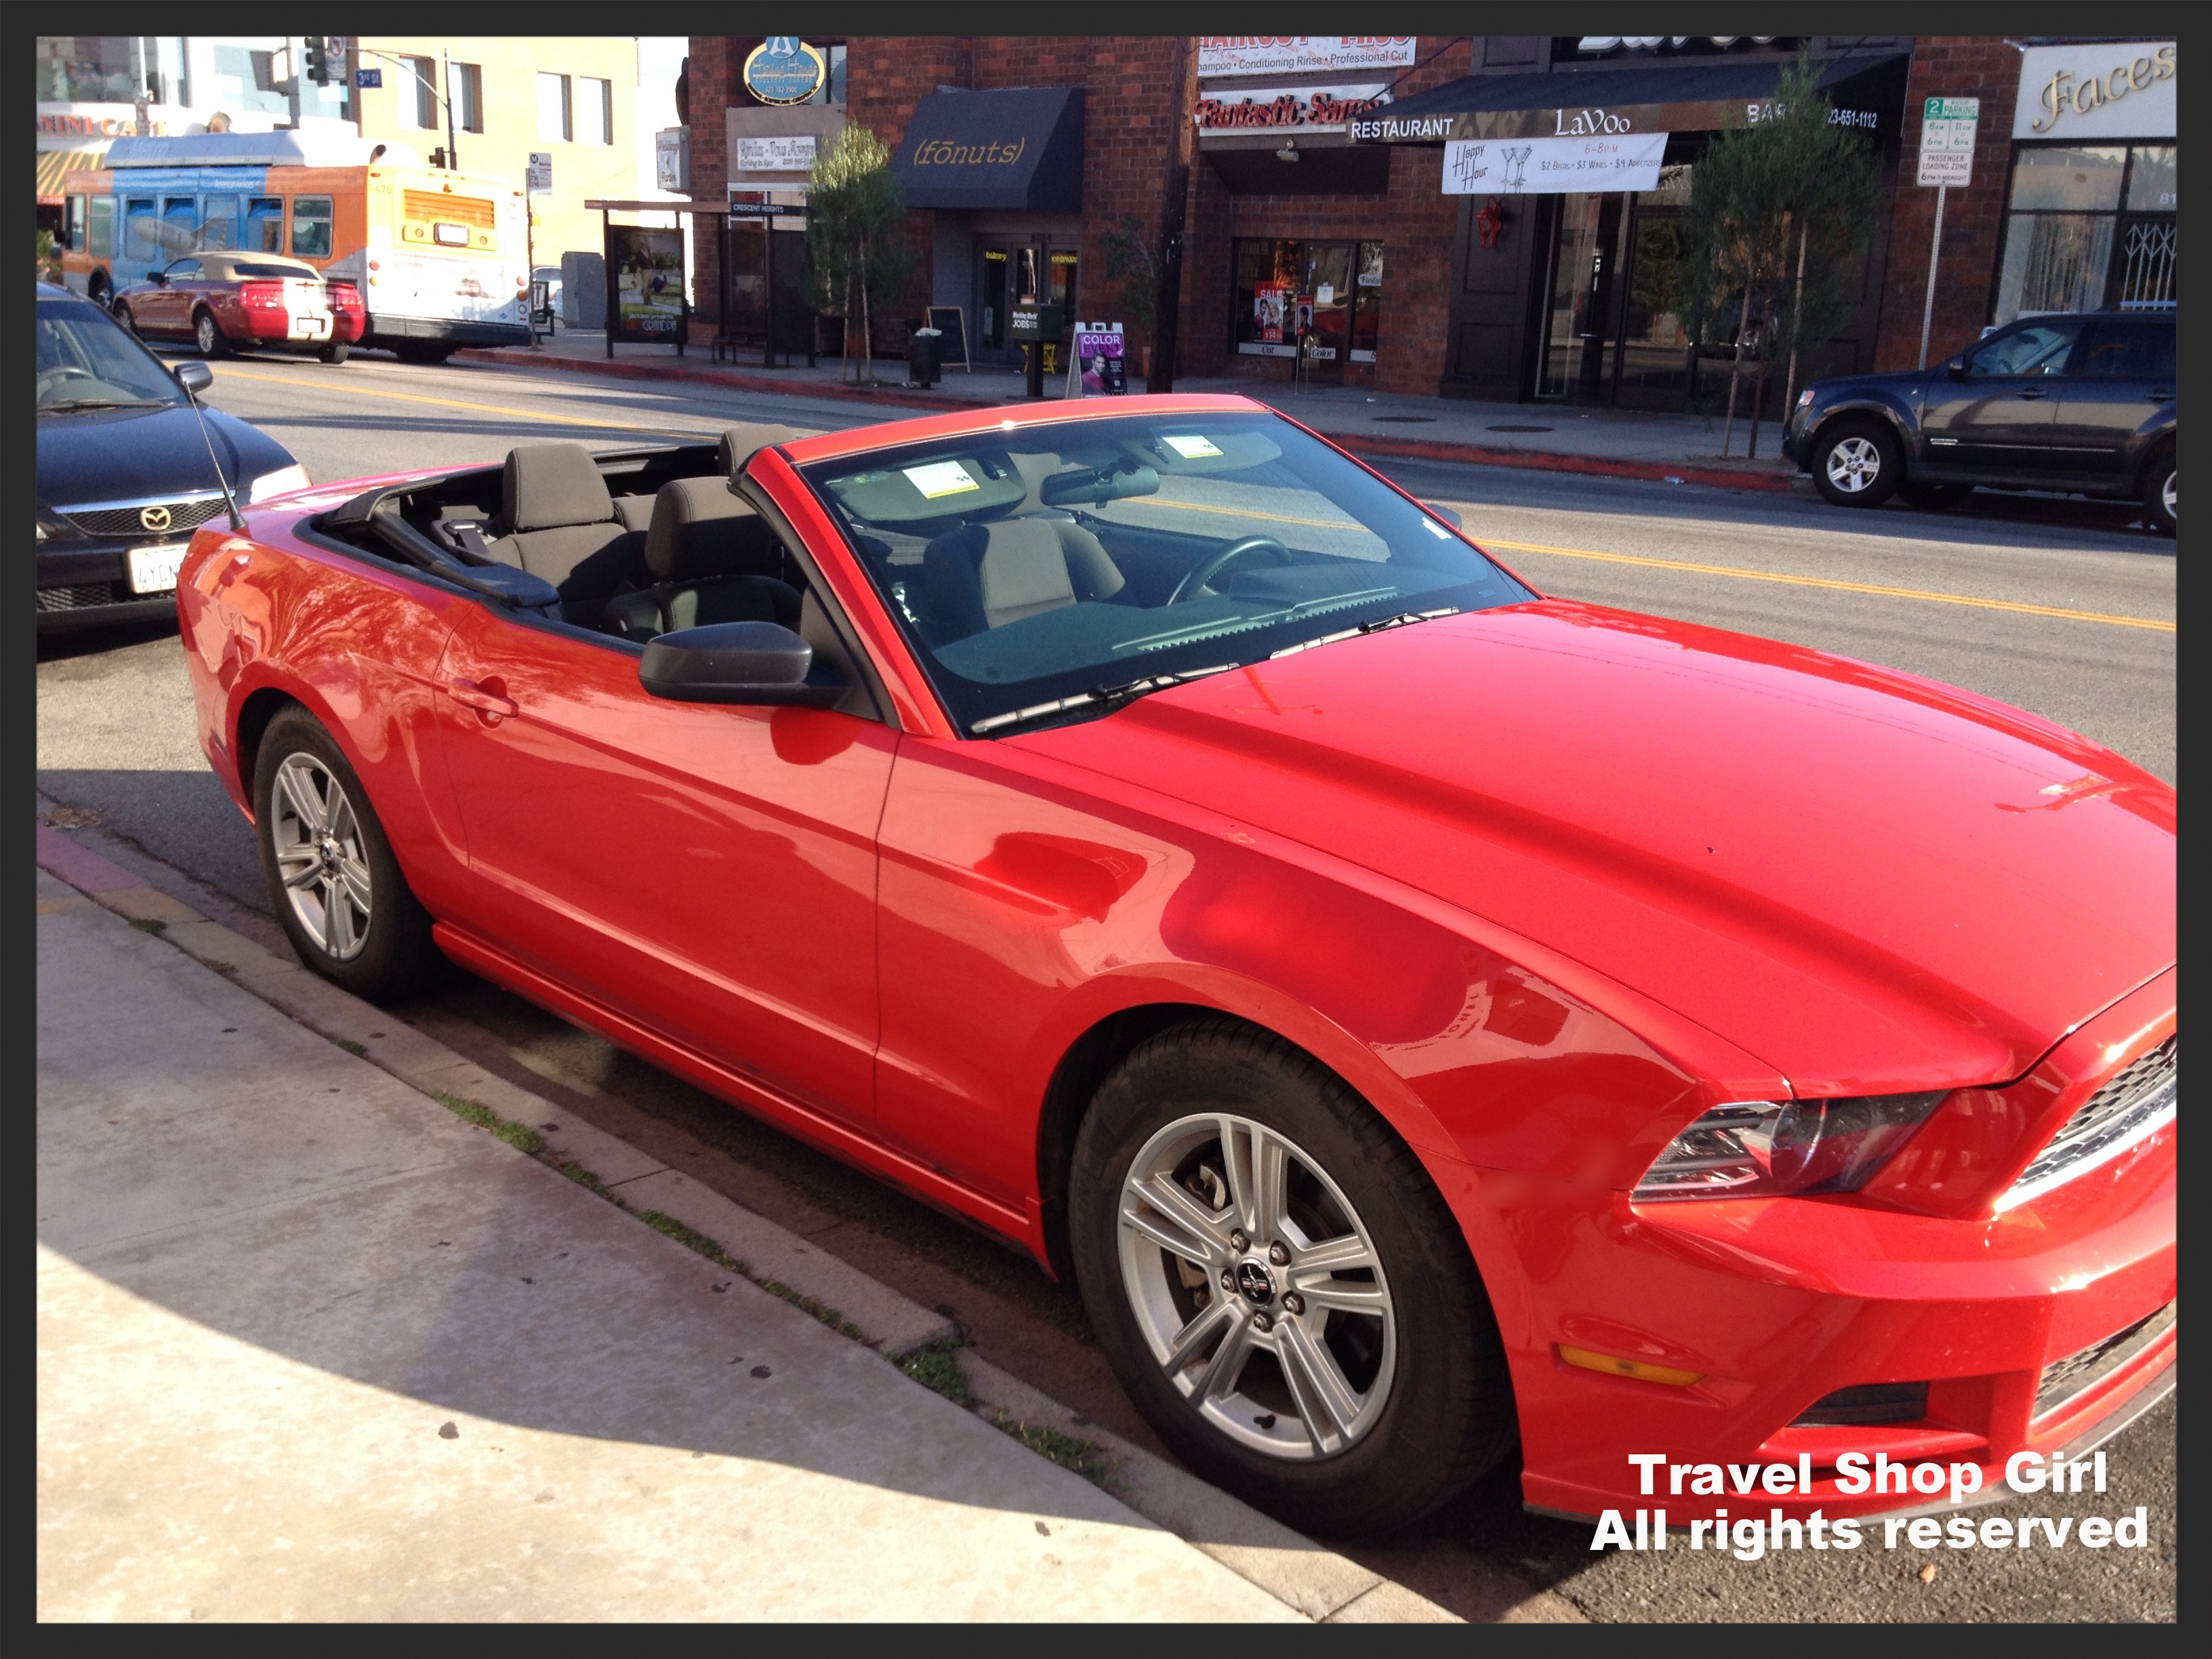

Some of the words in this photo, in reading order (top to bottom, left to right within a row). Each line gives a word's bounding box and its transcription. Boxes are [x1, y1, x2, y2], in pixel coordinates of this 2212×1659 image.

[1240, 56, 1294, 68] Conditioning
[1297, 56, 1322, 66] Rinse
[1330, 52, 1388, 64] Professional
[1391, 50, 1408, 61] Cut
[2032, 47, 2175, 133] Faces
[1195, 95, 1306, 127] Fantastic
[1929, 100, 1940, 113] 2
[1944, 105, 1976, 116] PARKING
[37, 114, 93, 134] NINI
[1555, 108, 1631, 136] LaVoo
[1828, 108, 1877, 128] 23-651-1112
[1351, 119, 1453, 138] RESTAURANT
[914, 137, 1025, 166] (fōnuts)
[1452, 144, 1485, 176] Happy
[1541, 161, 1551, 170] $2
[1577, 160, 1586, 169] $3
[1615, 159, 1625, 167] $4
[1462, 159, 1488, 190] Hour
[1012, 320, 1029, 328] JOBS
[1084, 335, 1120, 345] COLOR
[1312, 349, 1334, 357] Color
